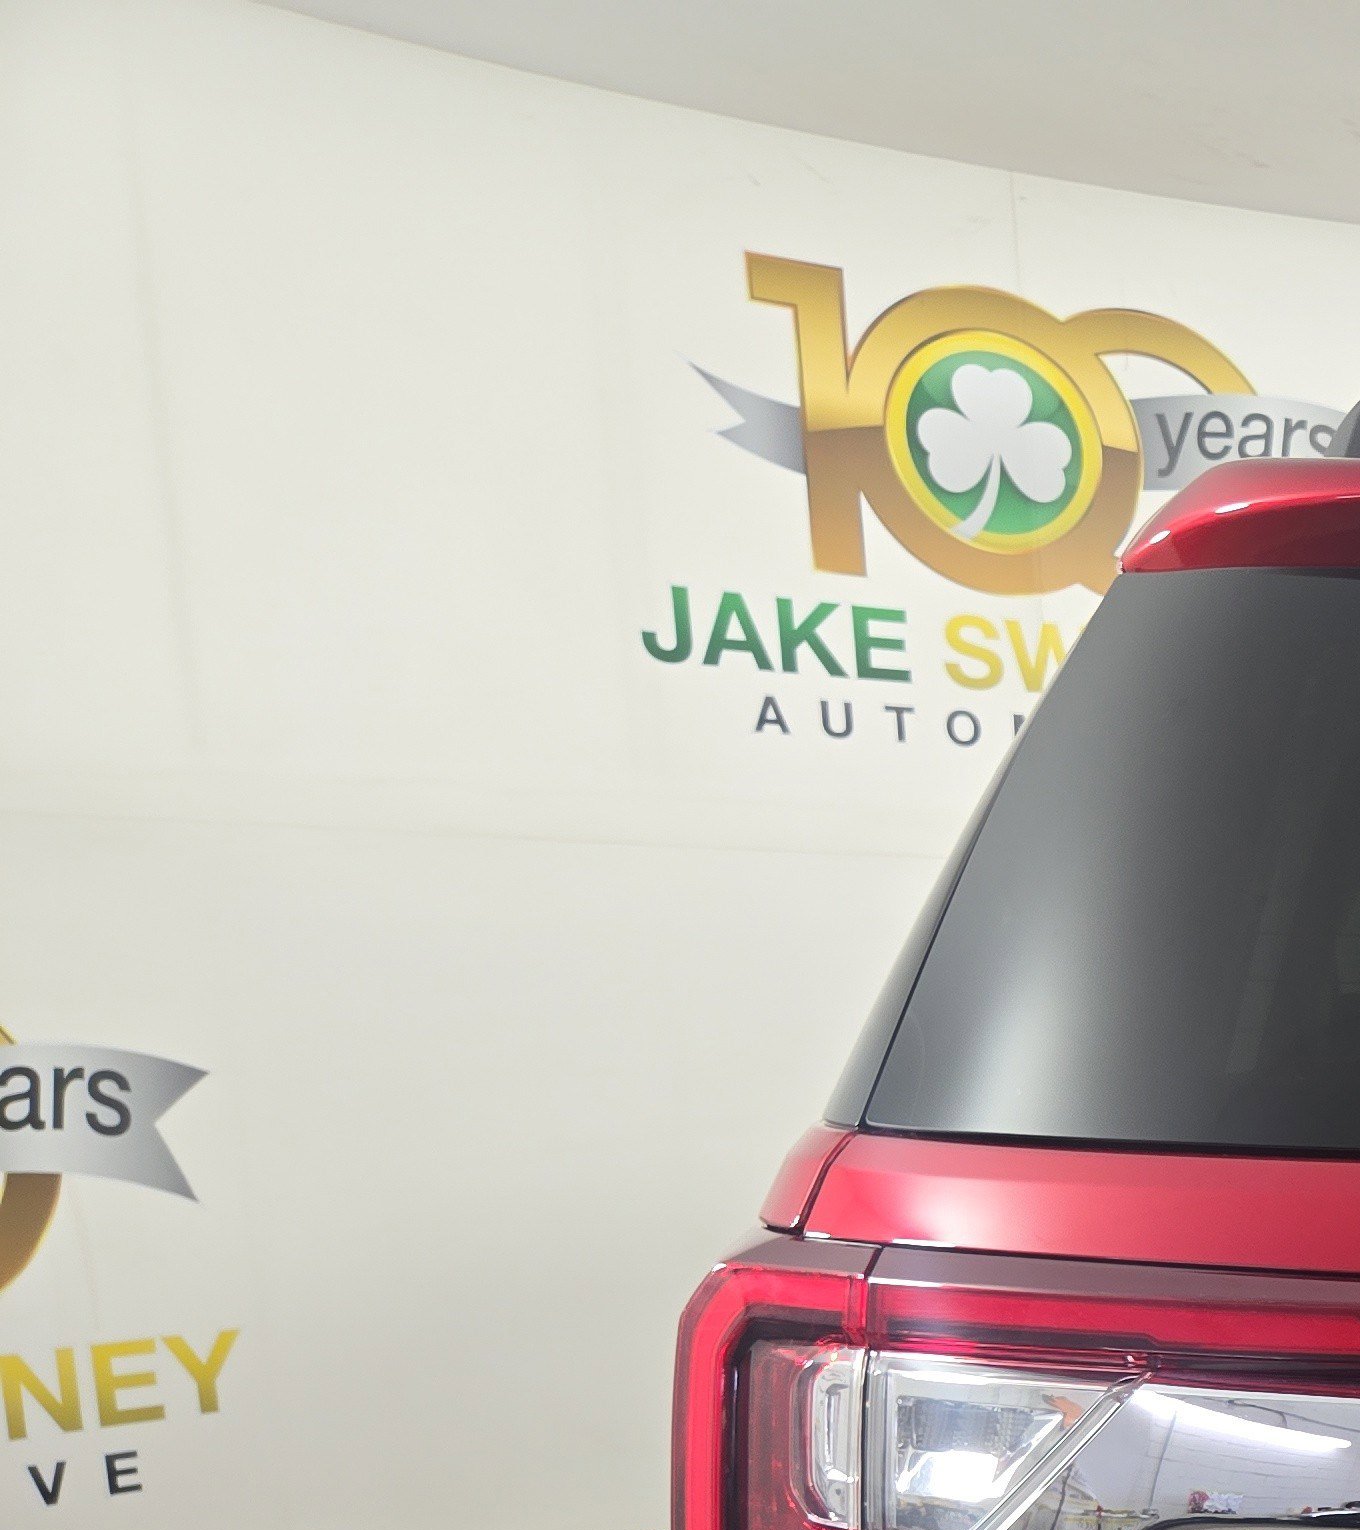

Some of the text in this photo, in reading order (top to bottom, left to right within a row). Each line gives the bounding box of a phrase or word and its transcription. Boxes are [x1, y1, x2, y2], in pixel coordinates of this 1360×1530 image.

[1156, 406, 1337, 478] years
[641, 584, 912, 683] JAKE
[754, 695, 1027, 747] AUTO
